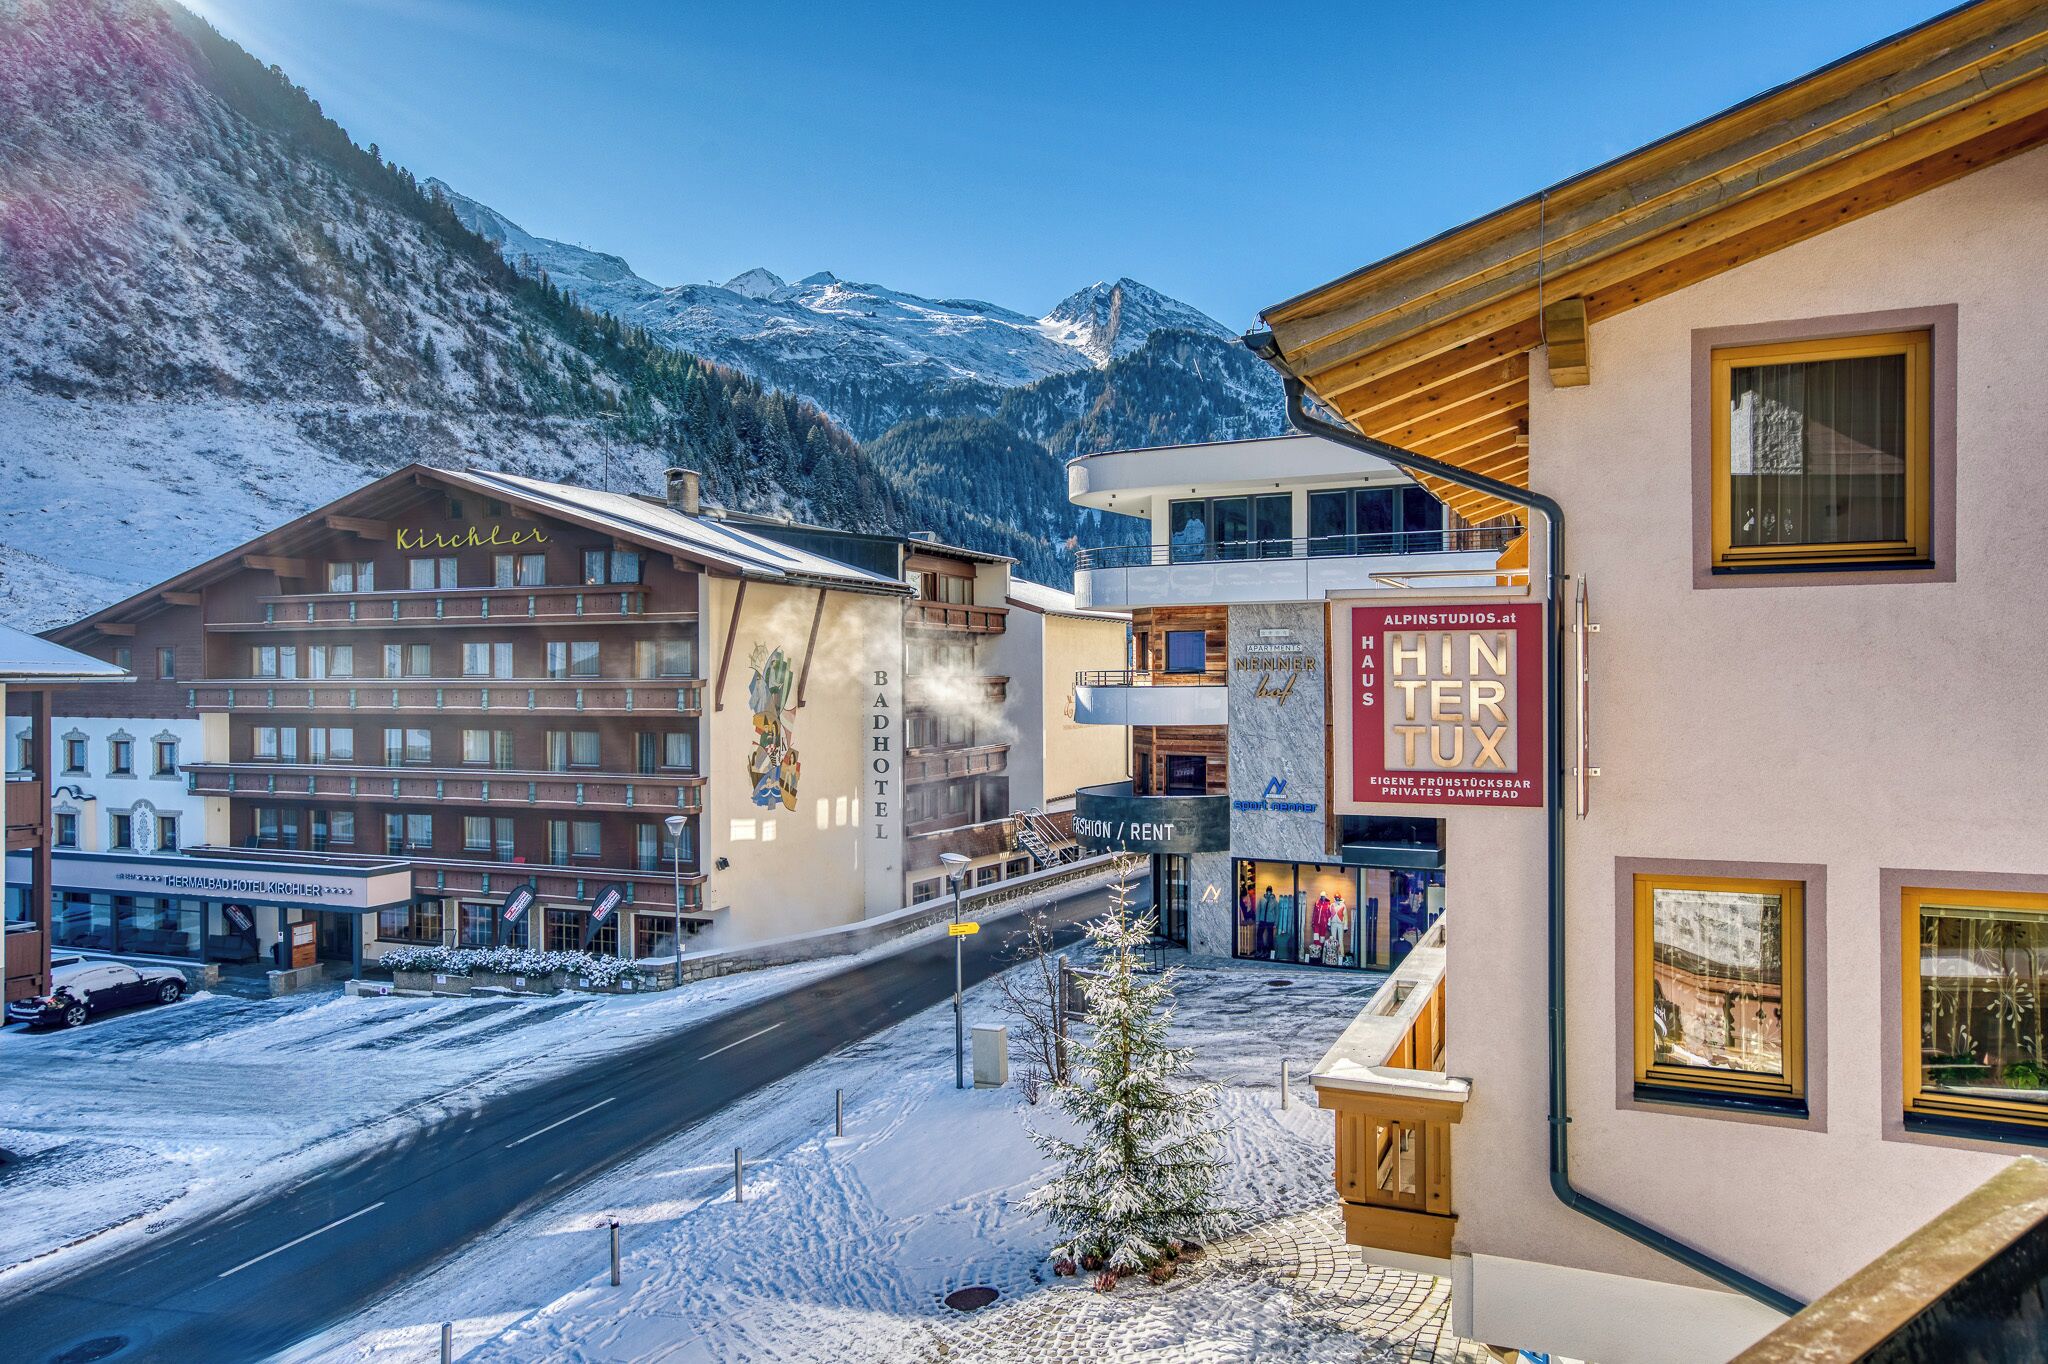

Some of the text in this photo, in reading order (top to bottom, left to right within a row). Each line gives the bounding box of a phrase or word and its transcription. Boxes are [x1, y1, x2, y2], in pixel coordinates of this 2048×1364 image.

[396, 525, 548, 550] Kirchler
[1384, 613, 1517, 625] ALPINSTUDIOS.at
[1247, 644, 1302, 653] APARTMENTS
[1392, 632, 1508, 676] HIN
[1235, 656, 1317, 672] NENNER
[1361, 636, 1375, 706] HAUS
[1255, 672, 1297, 707] hof
[1393, 680, 1508, 722] TER
[872, 670, 890, 839] BADHOTEL
[1393, 725, 1508, 768] TUX
[1370, 776, 1532, 789] EIGENE FRÜHSTÜCKSBAR
[1382, 787, 1519, 799] PRIVATES DAMPFBAD
[1233, 800, 1318, 813] sport nenner
[1072, 815, 1113, 839] FASHION
[1130, 822, 1175, 841] RENT
[163, 874, 322, 897] THERMALBAD HOTEL KIRCHLER
